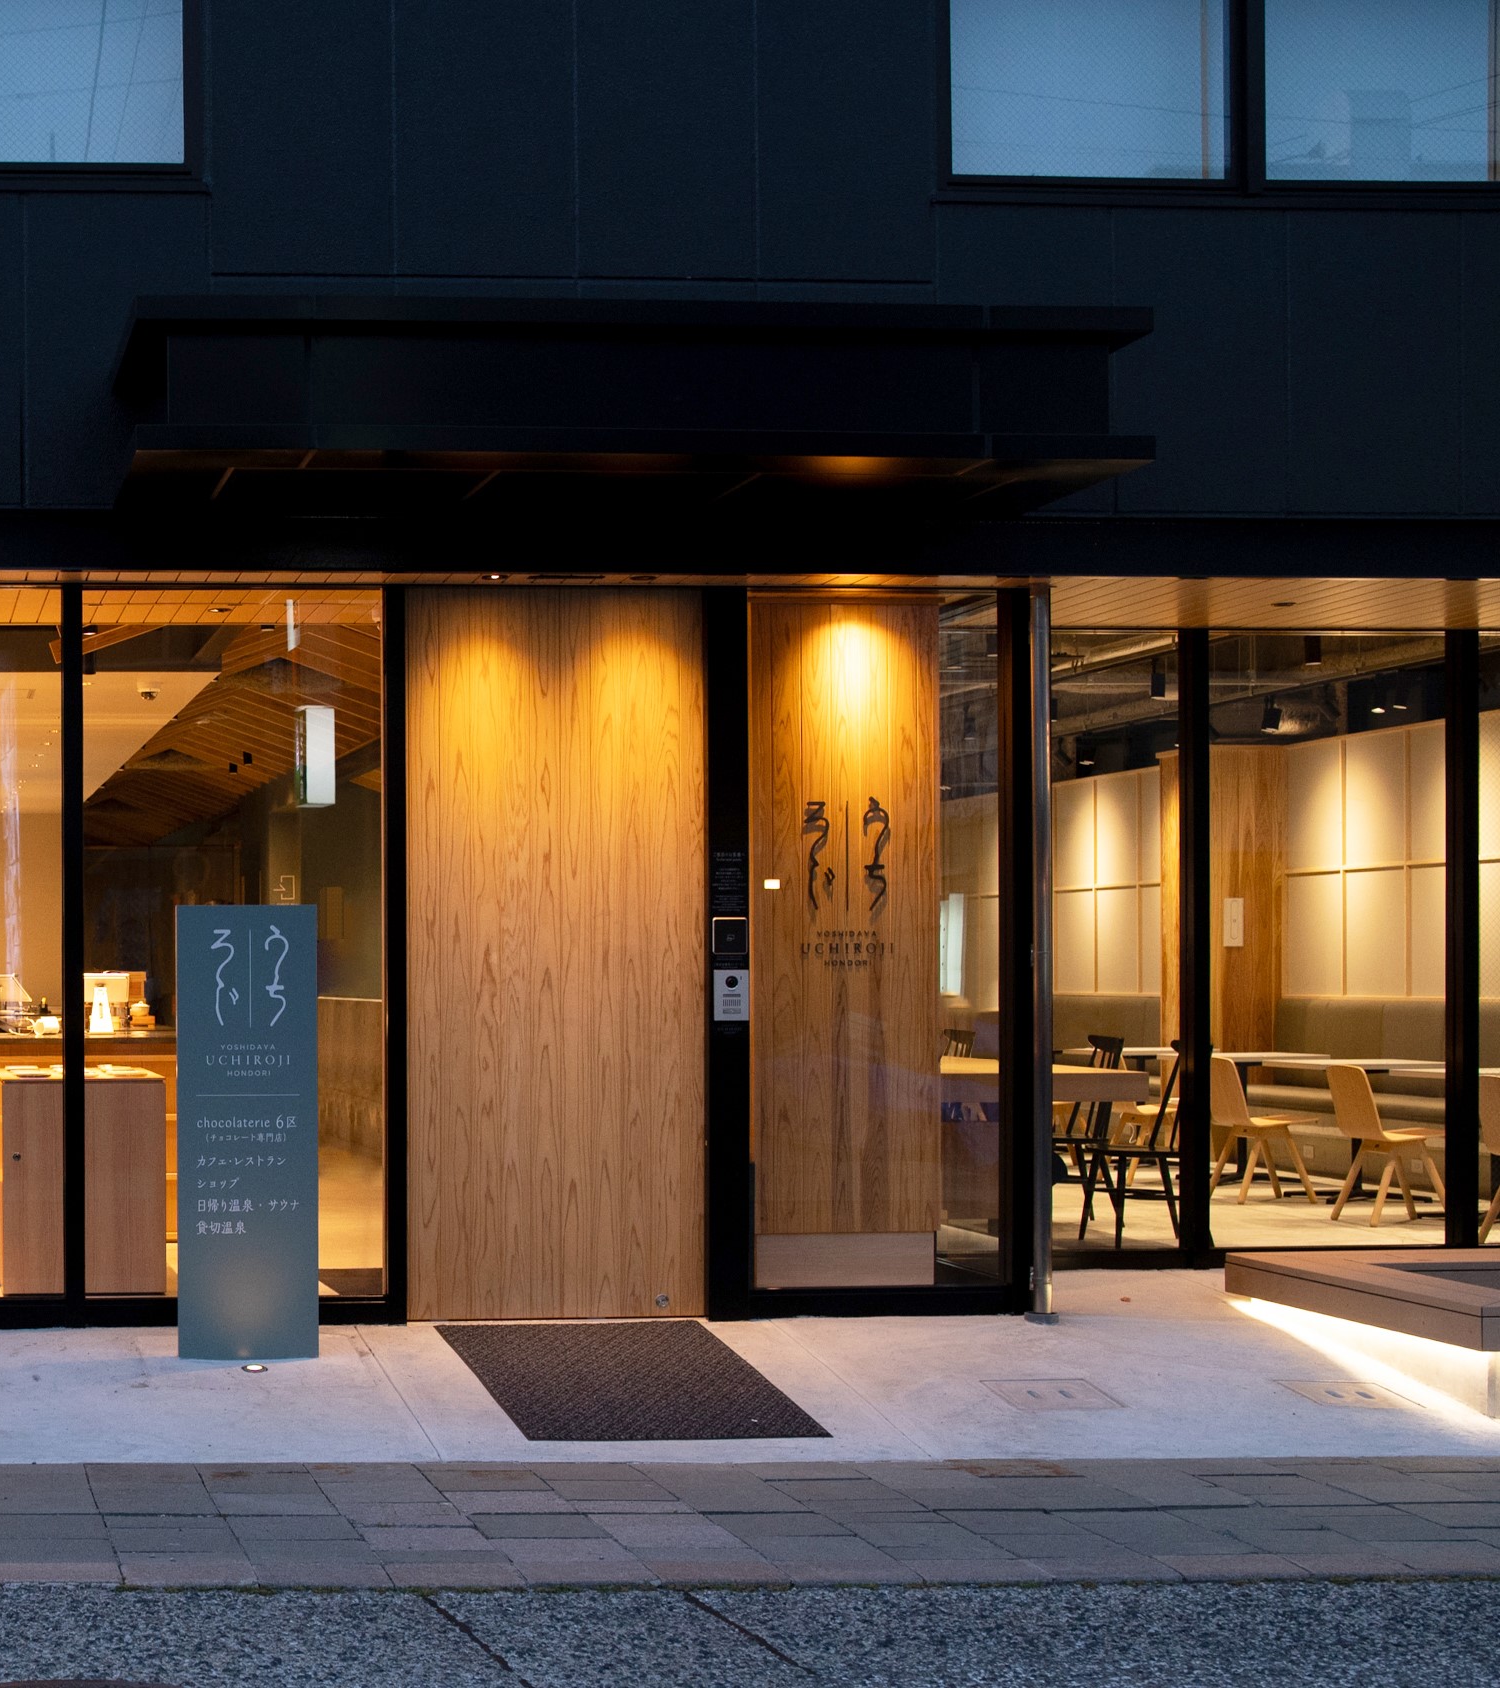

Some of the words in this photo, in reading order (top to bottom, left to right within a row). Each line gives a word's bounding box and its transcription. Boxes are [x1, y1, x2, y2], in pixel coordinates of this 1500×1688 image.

[816, 930, 877, 938] YOSHIDAYA
[801, 942, 894, 955] UCHIROJI
[824, 959, 872, 967] HONDORI
[220, 1043, 276, 1051] YOSHIDAYA
[206, 1054, 290, 1068] UCHIROJI
[226, 1069, 271, 1077] HONDORI
[196, 1116, 271, 1128] chocolaterie
[276, 1114, 297, 1129] 6区
[196, 1155, 286, 1169] カフェ・レストラン
[197, 1177, 240, 1189] ショップ
[196, 1220, 247, 1235] 貸切温泉
